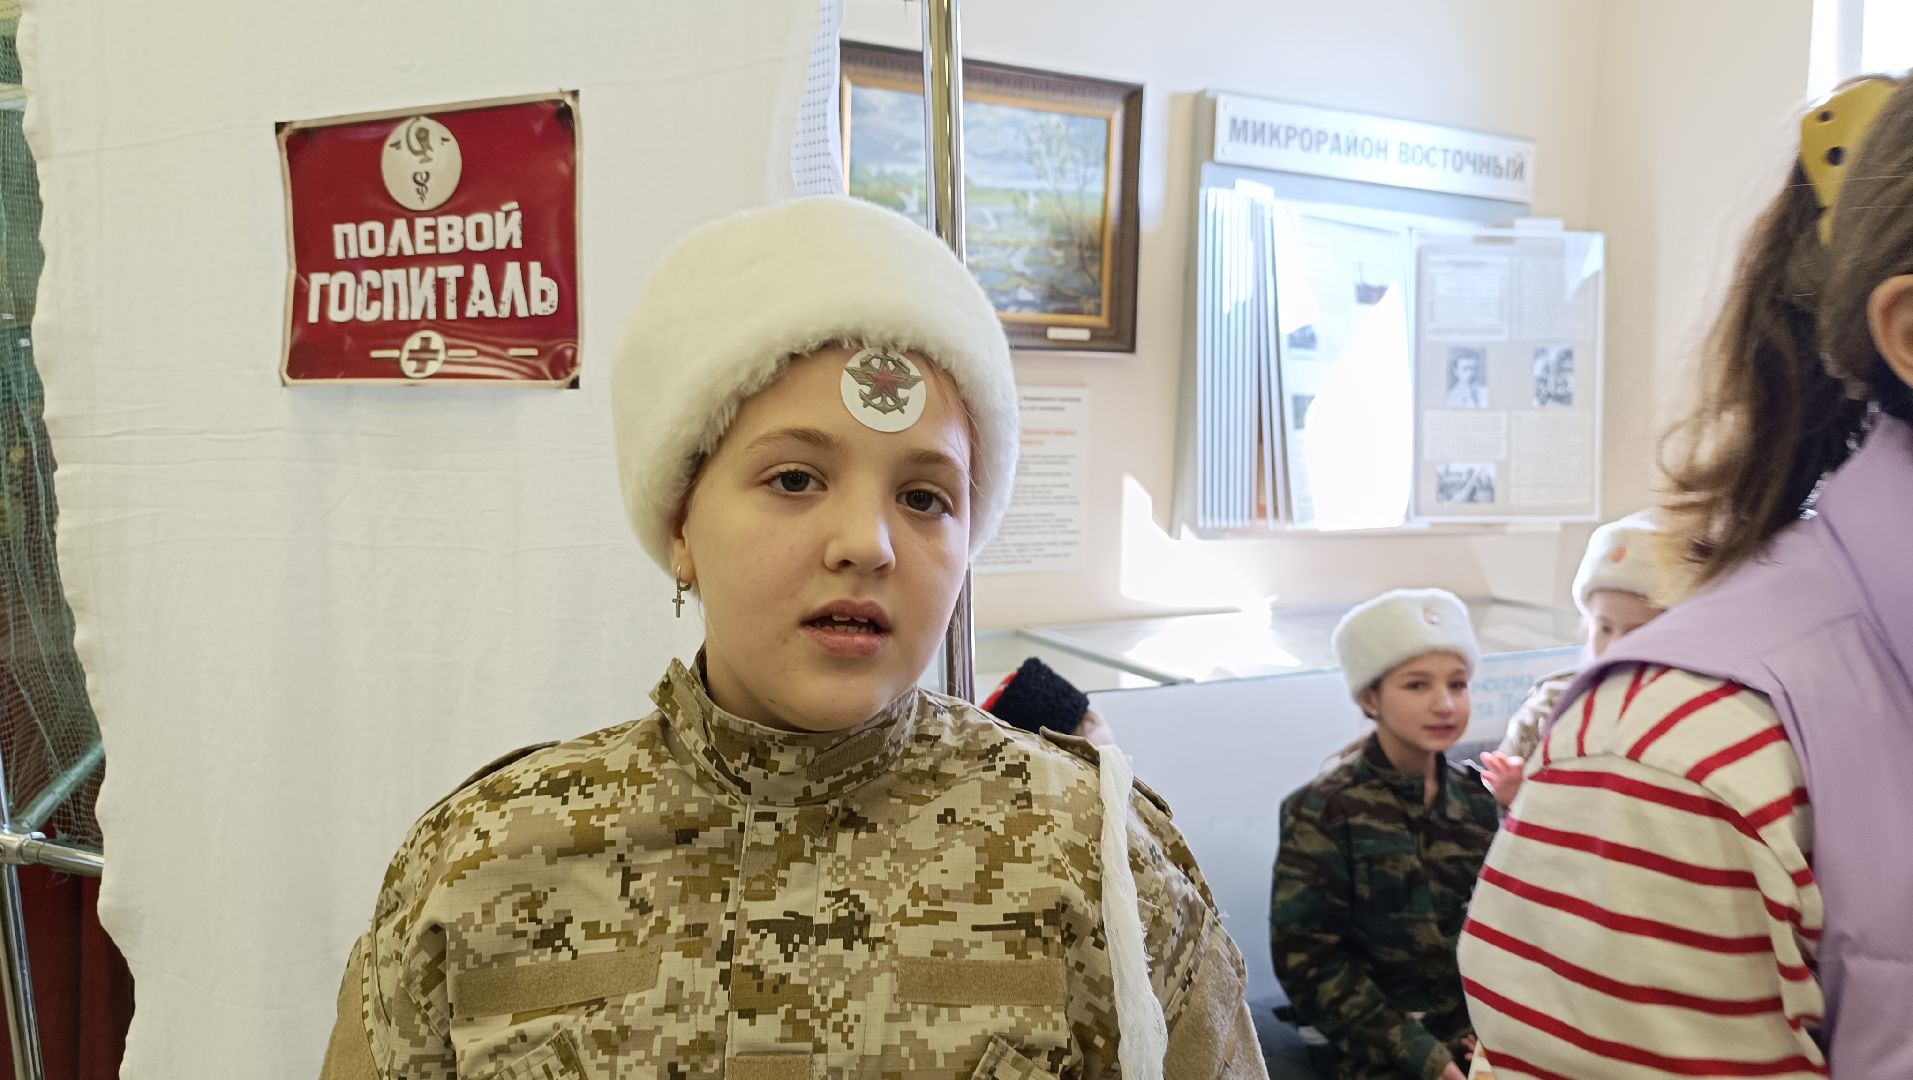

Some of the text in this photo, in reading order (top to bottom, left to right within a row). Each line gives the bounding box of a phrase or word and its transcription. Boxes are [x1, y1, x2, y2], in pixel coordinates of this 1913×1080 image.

[1228, 115, 1527, 184] МИКРОРАЙОН ВОСТОЧНЫЙ
[332, 201, 523, 260] ПОЛЕВОЙ
[307, 261, 559, 323] ГОСПИТАЛЬ
